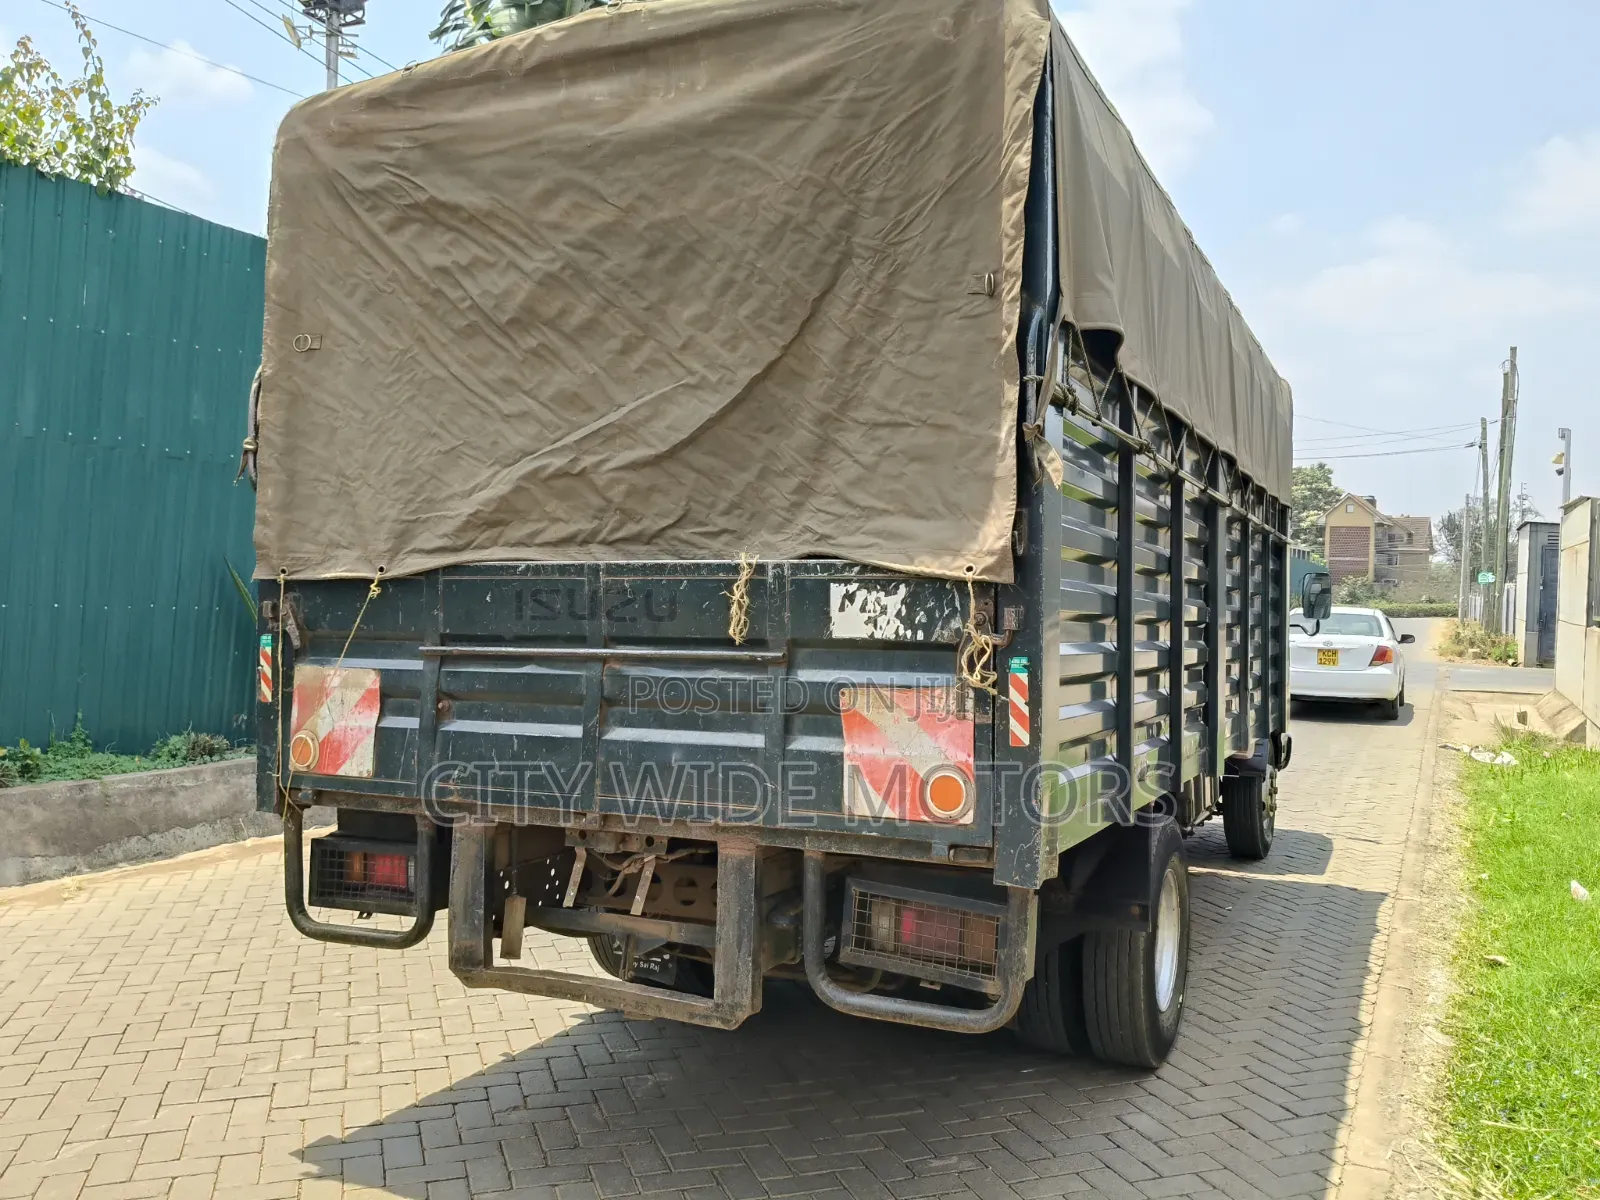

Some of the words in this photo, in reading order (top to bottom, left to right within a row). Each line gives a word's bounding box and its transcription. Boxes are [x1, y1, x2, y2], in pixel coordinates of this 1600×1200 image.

[514, 588, 678, 622] ISUZU
[1322, 649, 1337, 657] KCH
[1318, 657, 1336, 665] 129V
